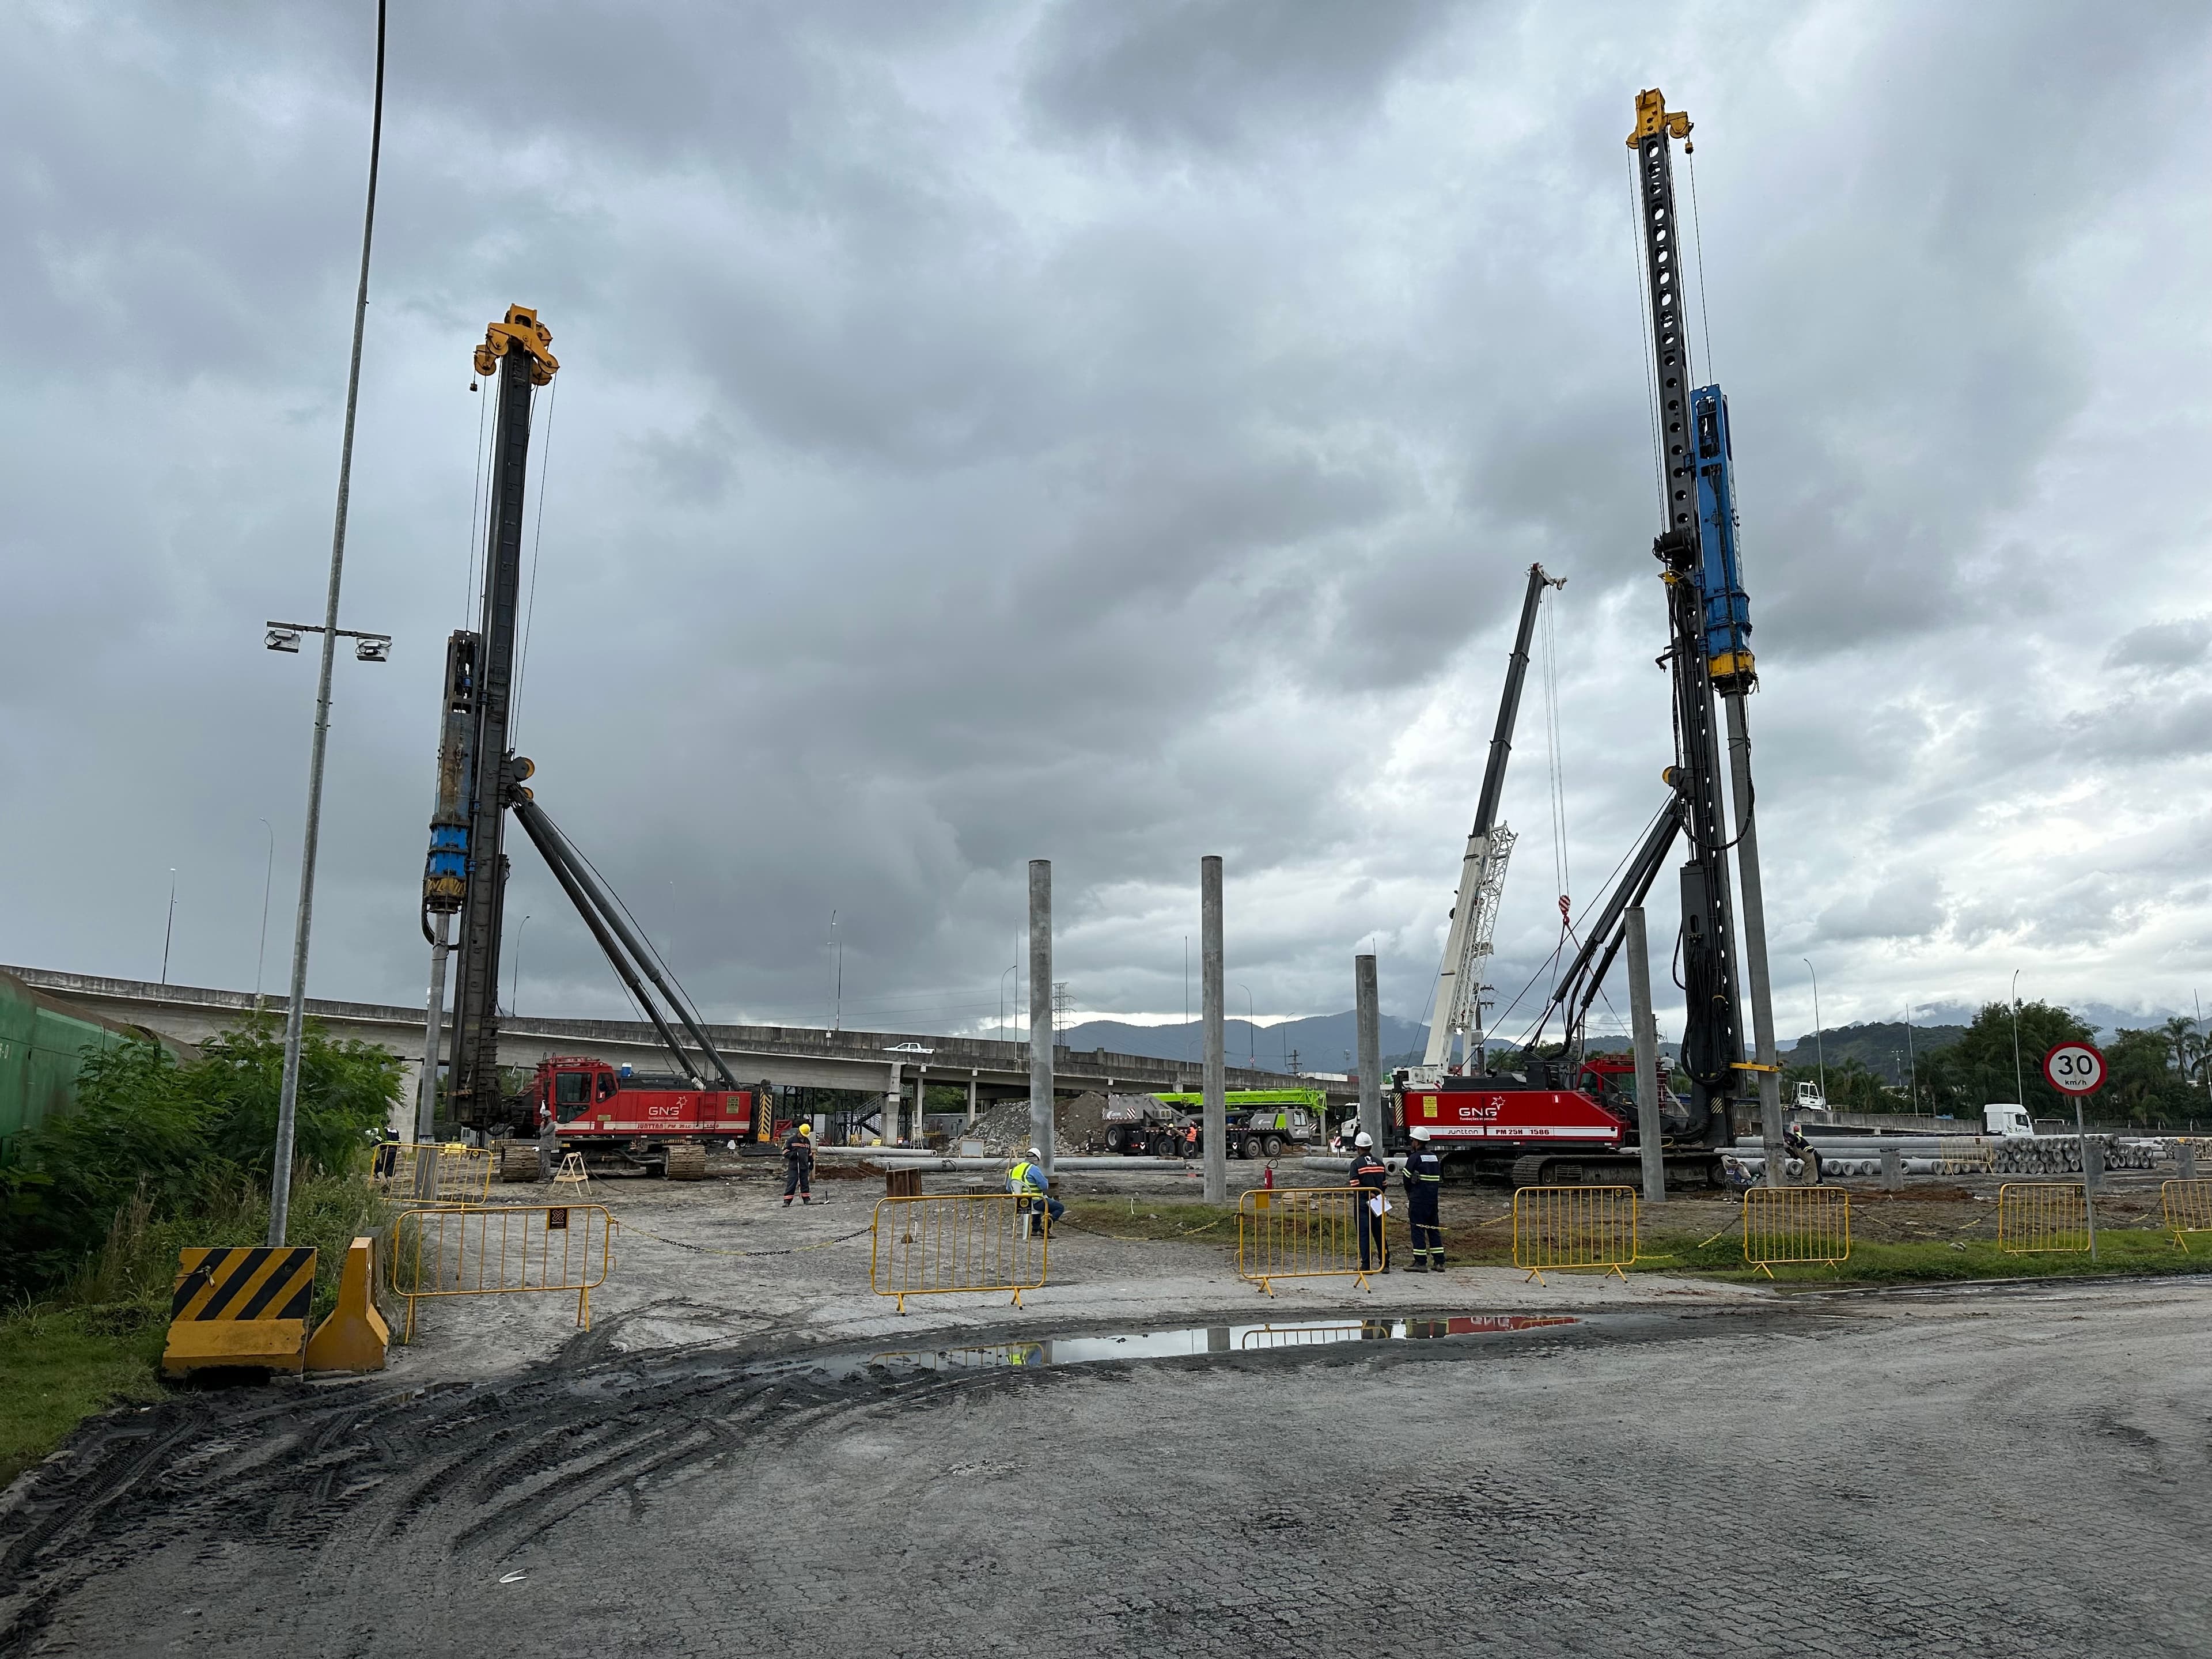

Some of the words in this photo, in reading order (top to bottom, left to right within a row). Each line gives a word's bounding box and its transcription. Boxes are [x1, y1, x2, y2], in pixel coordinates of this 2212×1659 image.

[2058, 1055, 2093, 1075] 30
[649, 1107, 679, 1115] GNG
[1459, 1107, 1497, 1116] GNG
